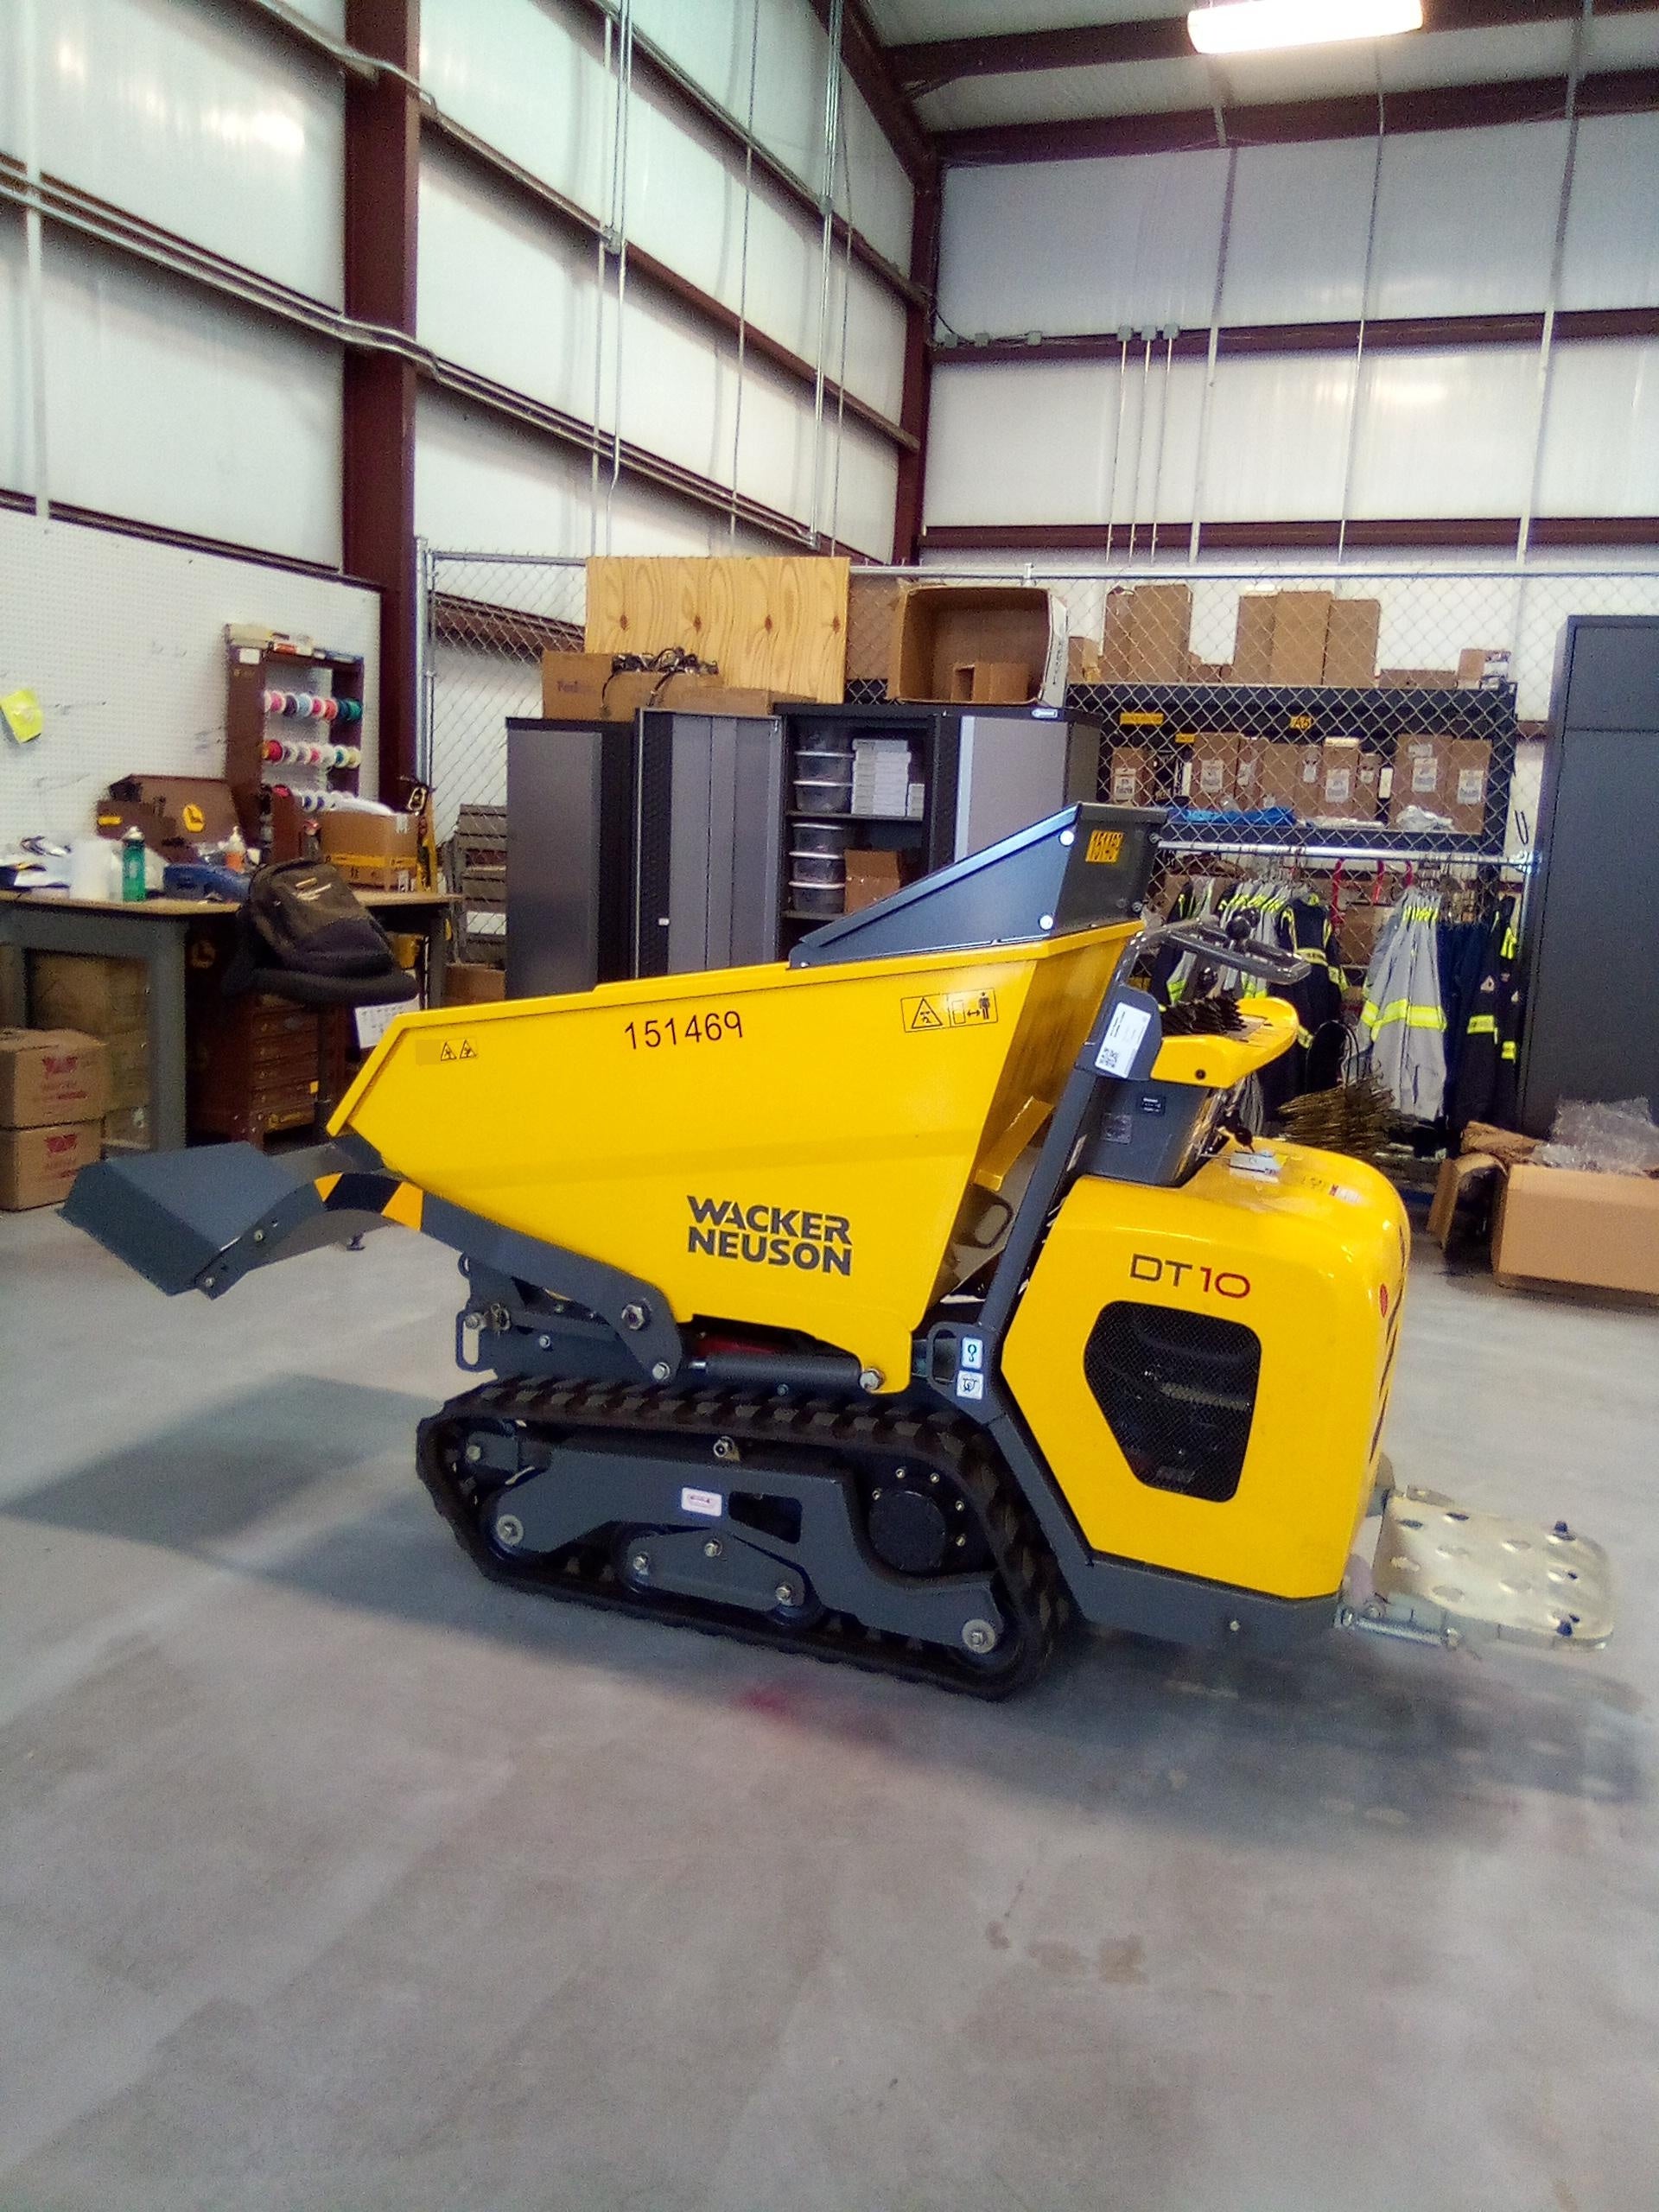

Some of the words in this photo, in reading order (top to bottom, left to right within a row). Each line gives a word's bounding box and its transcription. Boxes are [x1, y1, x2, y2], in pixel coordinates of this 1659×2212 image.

[624, 1010, 743, 1050] 151469
[687, 1194, 853, 1245] WACKER
[687, 1225, 852, 1276] NEUSON
